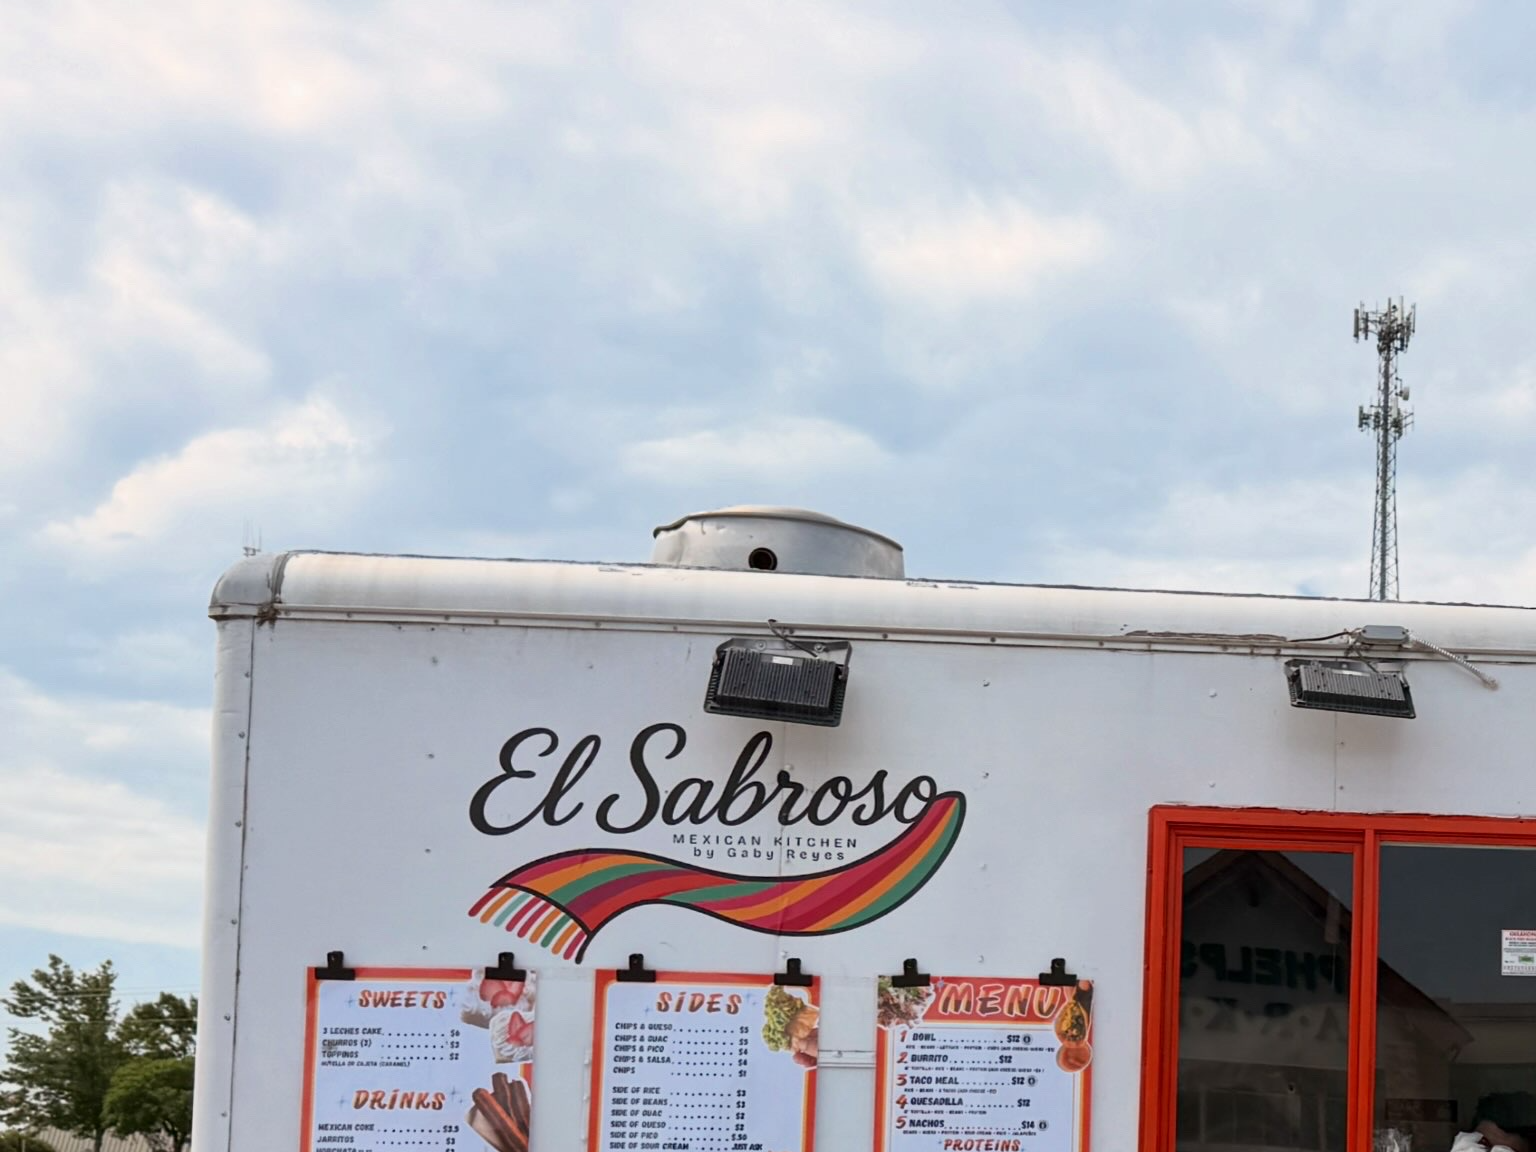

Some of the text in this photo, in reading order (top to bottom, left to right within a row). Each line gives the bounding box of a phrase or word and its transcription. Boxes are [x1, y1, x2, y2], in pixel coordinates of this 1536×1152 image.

[469, 722, 938, 836] El Sabroso
[673, 834, 857, 848] MEXICAN KITCHEN
[693, 847, 845, 861] by Gaby Reyes
[359, 989, 447, 1009] SWEETS
[938, 982, 1062, 1019] MENU
[912, 1033, 937, 1041] BOWL
[1007, 1034, 1020, 1043] $12
[911, 1054, 949, 1062] BURRITO
[999, 1055, 1012, 1064] $12
[910, 1076, 932, 1085] TACO
[935, 1077, 959, 1085] MEAL
[1012, 1077, 1025, 1085] $12
[896, 1094, 1030, 1109] 4 QUESADILLA $12
[909, 1119, 944, 1128] NACHOS
